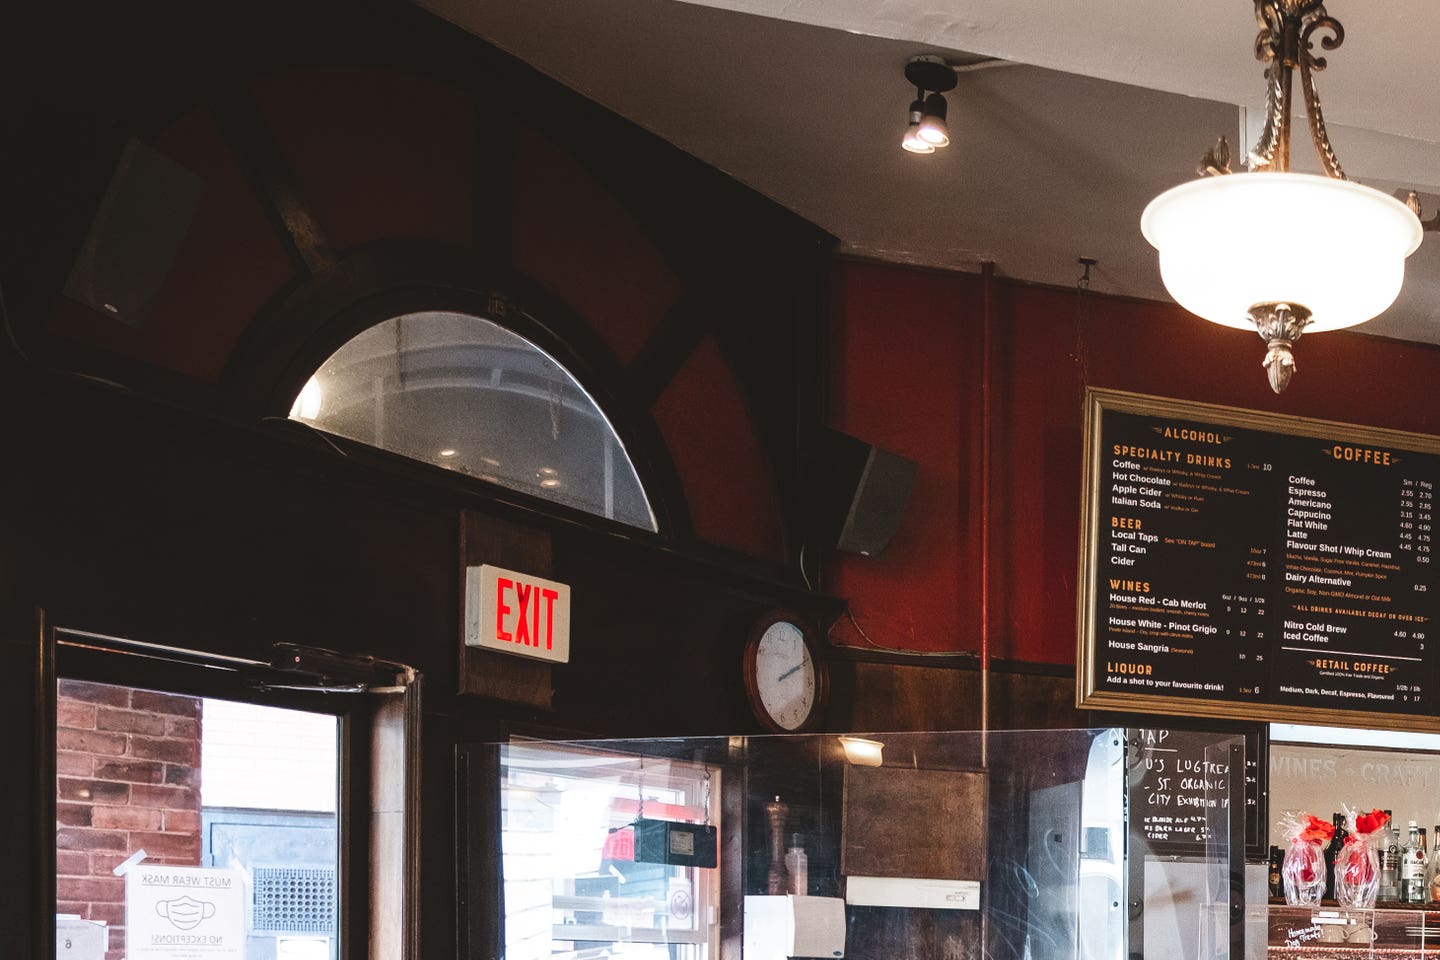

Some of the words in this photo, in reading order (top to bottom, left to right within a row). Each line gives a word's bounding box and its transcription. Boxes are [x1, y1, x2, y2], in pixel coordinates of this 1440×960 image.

[1164, 427, 1221, 444] ALCOHOL
[1114, 445, 1180, 462] SPECIALTY
[1187, 454, 1231, 469] DRINKS
[1333, 446, 1390, 465] COFFEE
[1113, 460, 1140, 470] Coffee
[1263, 463, 1272, 471] 10
[1113, 472, 1127, 481] Hot
[1130, 474, 1171, 486] Chocolate
[1289, 476, 1315, 485] Coffee
[1113, 484, 1137, 495] Apple
[1139, 487, 1162, 497] Cider
[1289, 487, 1326, 497] Espresso
[1112, 497, 1137, 506] Italian
[1140, 499, 1161, 509] Soda
[1288, 498, 1331, 509] Americano
[1288, 508, 1331, 520] Cappucino
[1112, 517, 1141, 530] BEER
[1288, 520, 1302, 528] Flat
[1304, 521, 1327, 530] White
[1112, 530, 1135, 540] Local
[1138, 533, 1158, 543] Taps
[1287, 530, 1307, 539] Latte
[1112, 543, 1126, 551] Tall
[1129, 545, 1146, 554] Can
[1287, 541, 1317, 551] Flavour
[1319, 544, 1337, 553] Shot
[1344, 547, 1364, 557] Whip
[1366, 549, 1391, 558] Cream
[1111, 556, 1135, 566] Cider
[1110, 579, 1150, 592] WINES
[1286, 573, 1307, 583] Dairy
[1309, 575, 1351, 586] Alternative
[1110, 593, 1136, 603] House
[1139, 596, 1155, 605] Red
[1163, 598, 1179, 607] Cab
[1181, 600, 1206, 610] Merlot
[497, 578, 558, 650] EXIT
[1109, 617, 1136, 626] House
[1138, 619, 1161, 628] White
[1169, 622, 1190, 631] Pinot
[1192, 624, 1217, 634] Grigio
[1284, 621, 1304, 629] Nitro
[1306, 623, 1324, 631] Cold
[1327, 625, 1347, 633] Brew
[1109, 641, 1135, 649] House
[1138, 643, 1168, 653] Sangria
[1107, 662, 1152, 675] LIQUOR
[1316, 660, 1349, 670] RETAIL
[1354, 663, 1389, 674] COFFEE
[1107, 676, 1121, 684] Add
[1129, 677, 1144, 685] shot
[1146, 678, 1153, 686] to
[1155, 680, 1170, 688] your
[1172, 680, 1202, 689] favourite
[1204, 682, 1224, 691] drink!
[1181, 778, 1225, 790] ORGANIC
[1148, 793, 1171, 806] CITY
